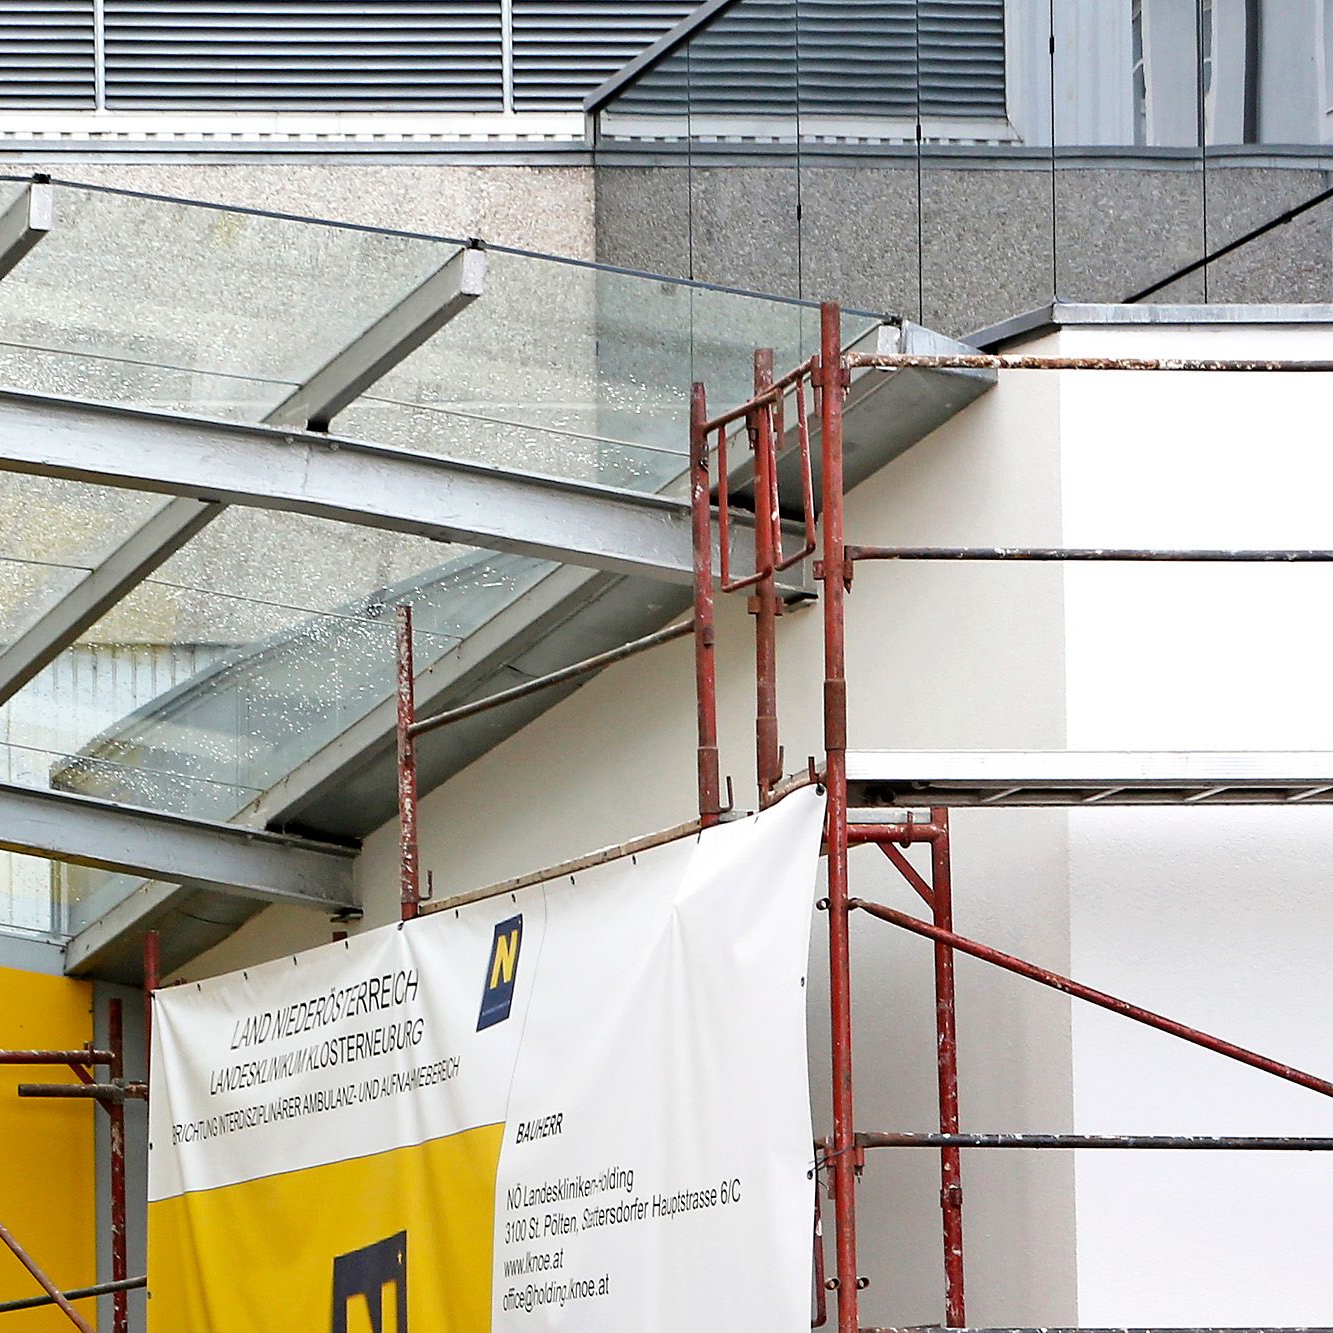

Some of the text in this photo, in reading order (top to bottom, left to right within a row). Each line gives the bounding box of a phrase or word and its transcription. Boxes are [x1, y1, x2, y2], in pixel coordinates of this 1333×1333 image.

[489, 929, 517, 990] N
[231, 967, 419, 1050] LAND NIEDERÖSTERREICH
[210, 1018, 425, 1096] LANDESKLINIKUM KLOSTERNEUBURG
[302, 1084, 357, 1115] AMBULANZ-
[359, 1078, 379, 1102] UND
[516, 1112, 563, 1144] BAUHERR
[505, 1219, 526, 1244] 3100
[528, 1216, 541, 1240] St.
[544, 1212, 579, 1237] Pölten,
[653, 1186, 717, 1220] Hauptstrasse
[721, 1178, 741, 1205] 6/C
[507, 1181, 521, 1210] NÖ
